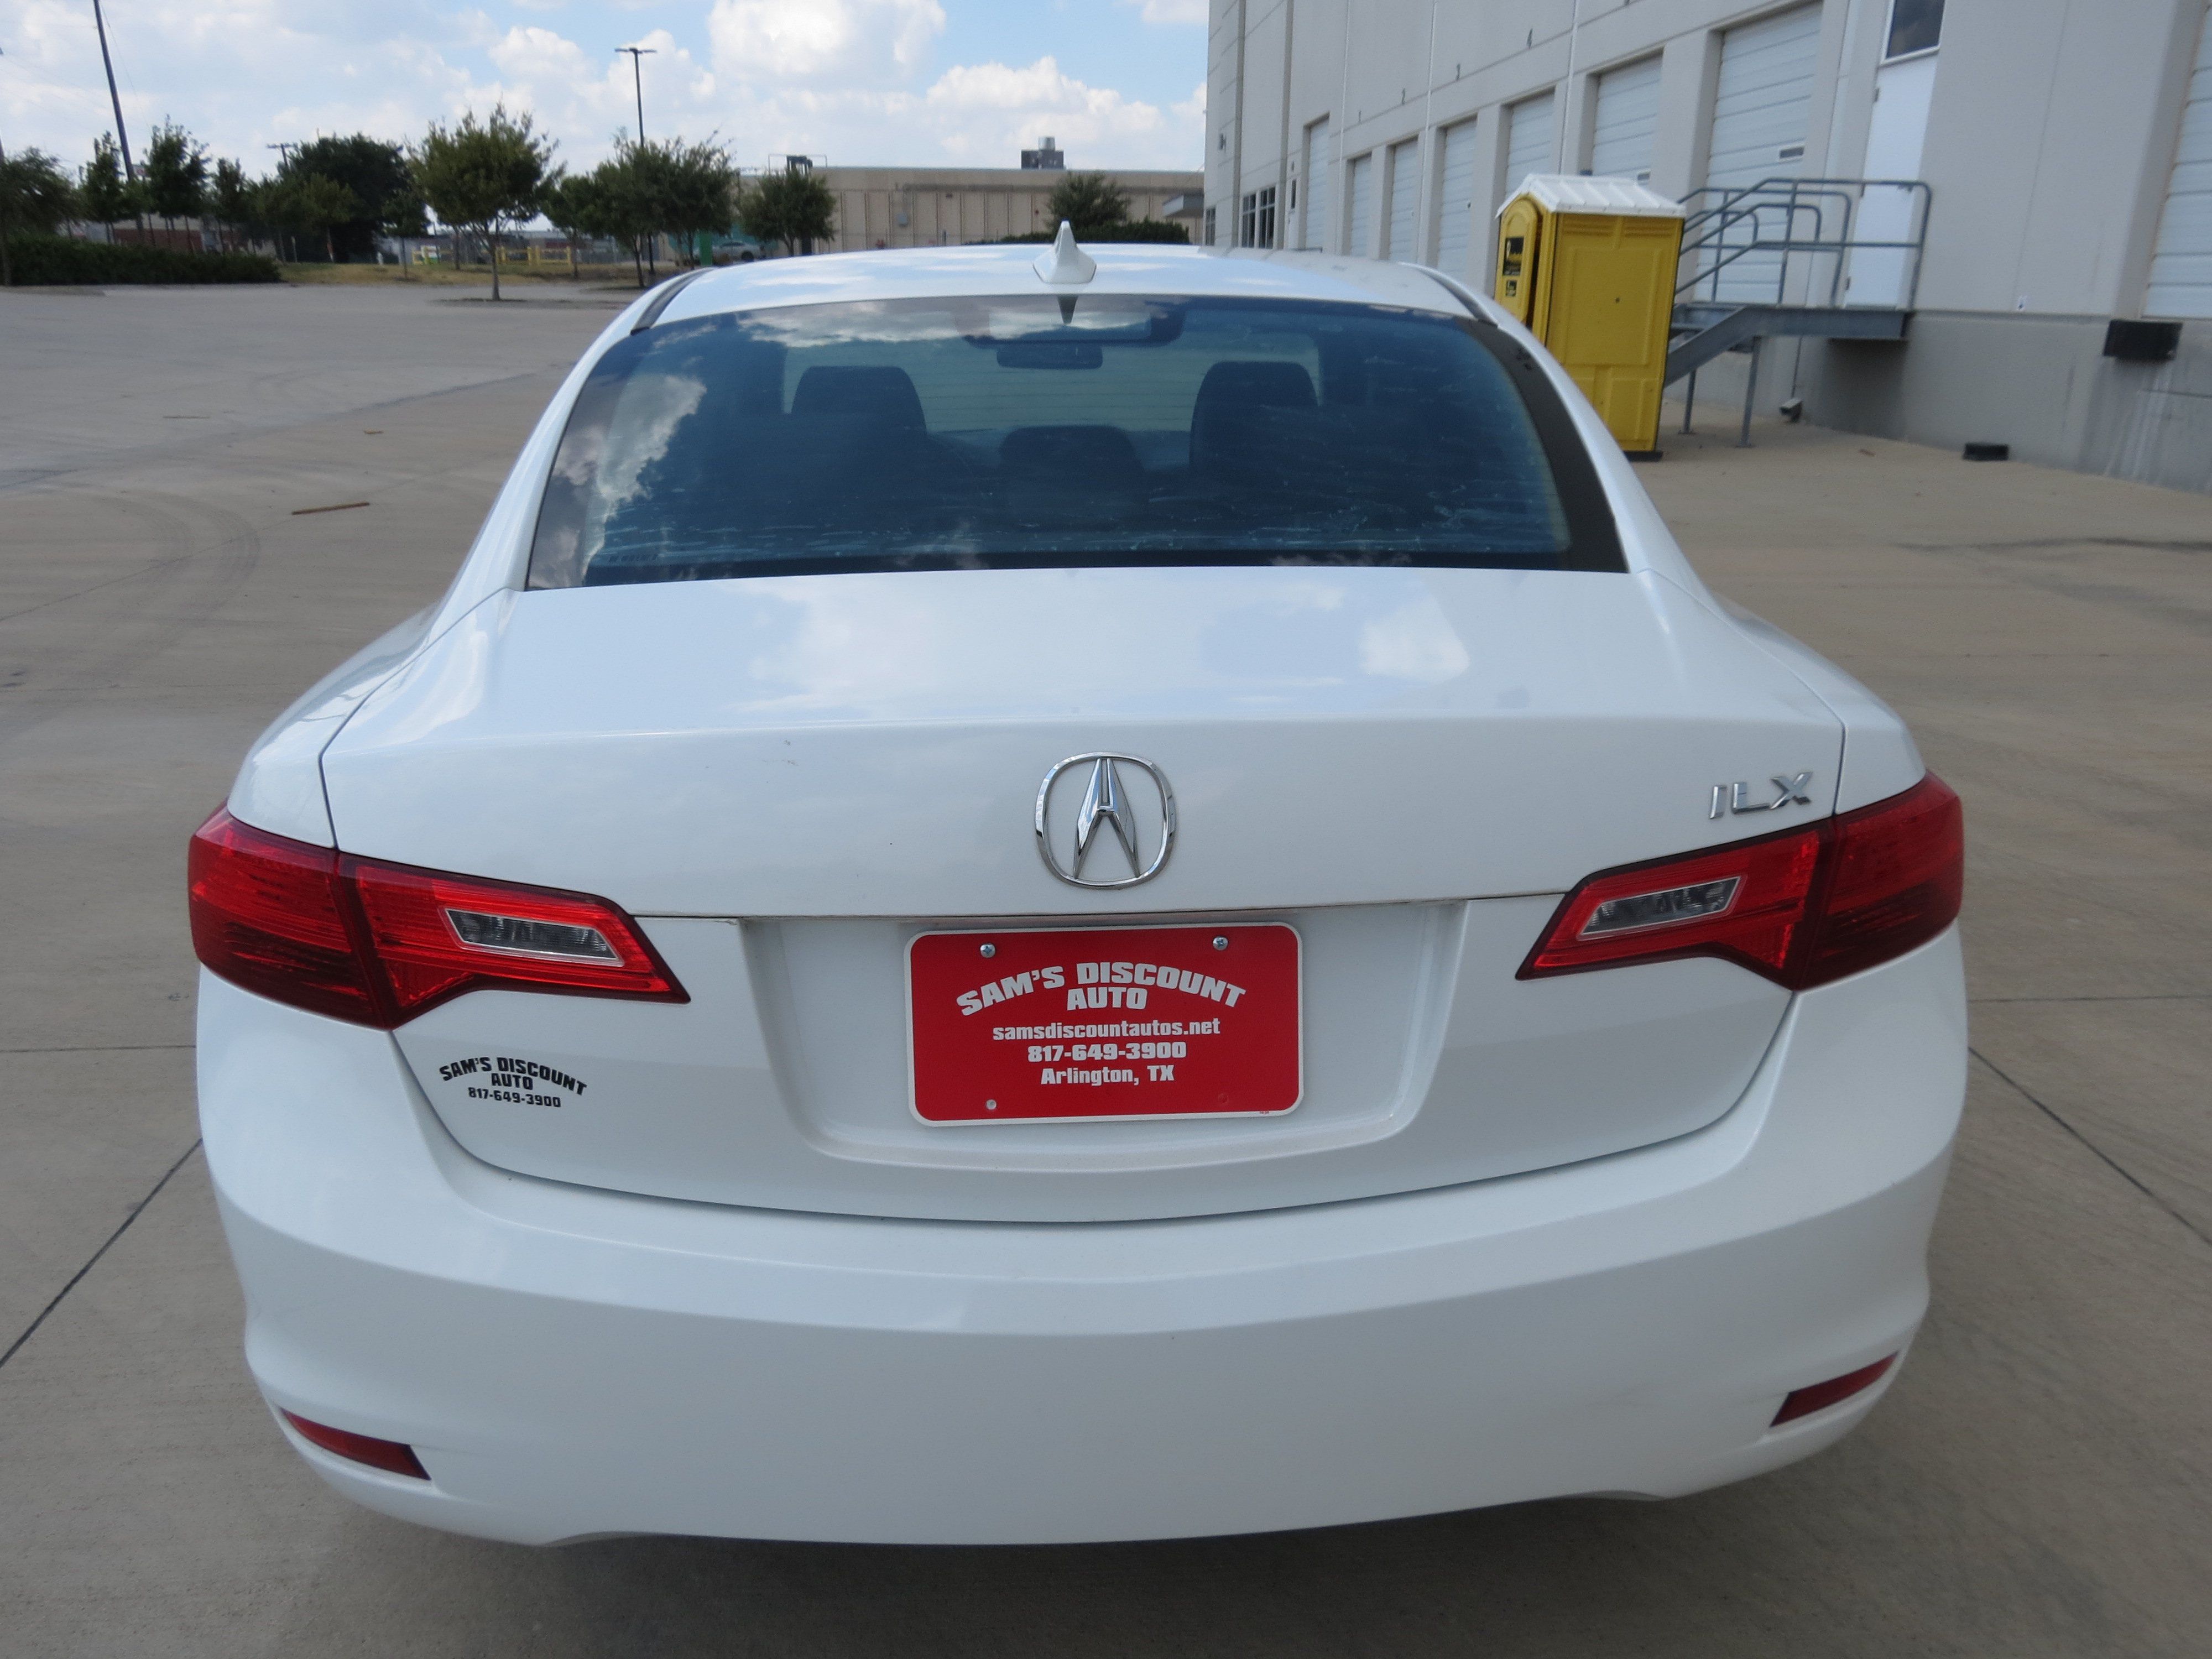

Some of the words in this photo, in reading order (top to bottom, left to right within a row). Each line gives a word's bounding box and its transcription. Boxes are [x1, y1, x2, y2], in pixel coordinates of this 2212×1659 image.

[1709, 771, 1813, 820] ILX
[956, 966, 1065, 1016] SAM'S
[1076, 962, 1246, 1008] DISCOUNT
[1067, 987, 1147, 1011] AUTO
[993, 1018, 1220, 1040] samsdiscountautos.net
[1027, 1041, 1187, 1062] 817-649-3900
[439, 1057, 492, 1082] SAM'S
[496, 1057, 588, 1096] DISCOUNT
[491, 1072, 534, 1091] AUTO
[1040, 1066, 1139, 1086] Arlington,
[1146, 1065, 1175, 1082] TX
[468, 1087, 561, 1108] 817-649-3900
